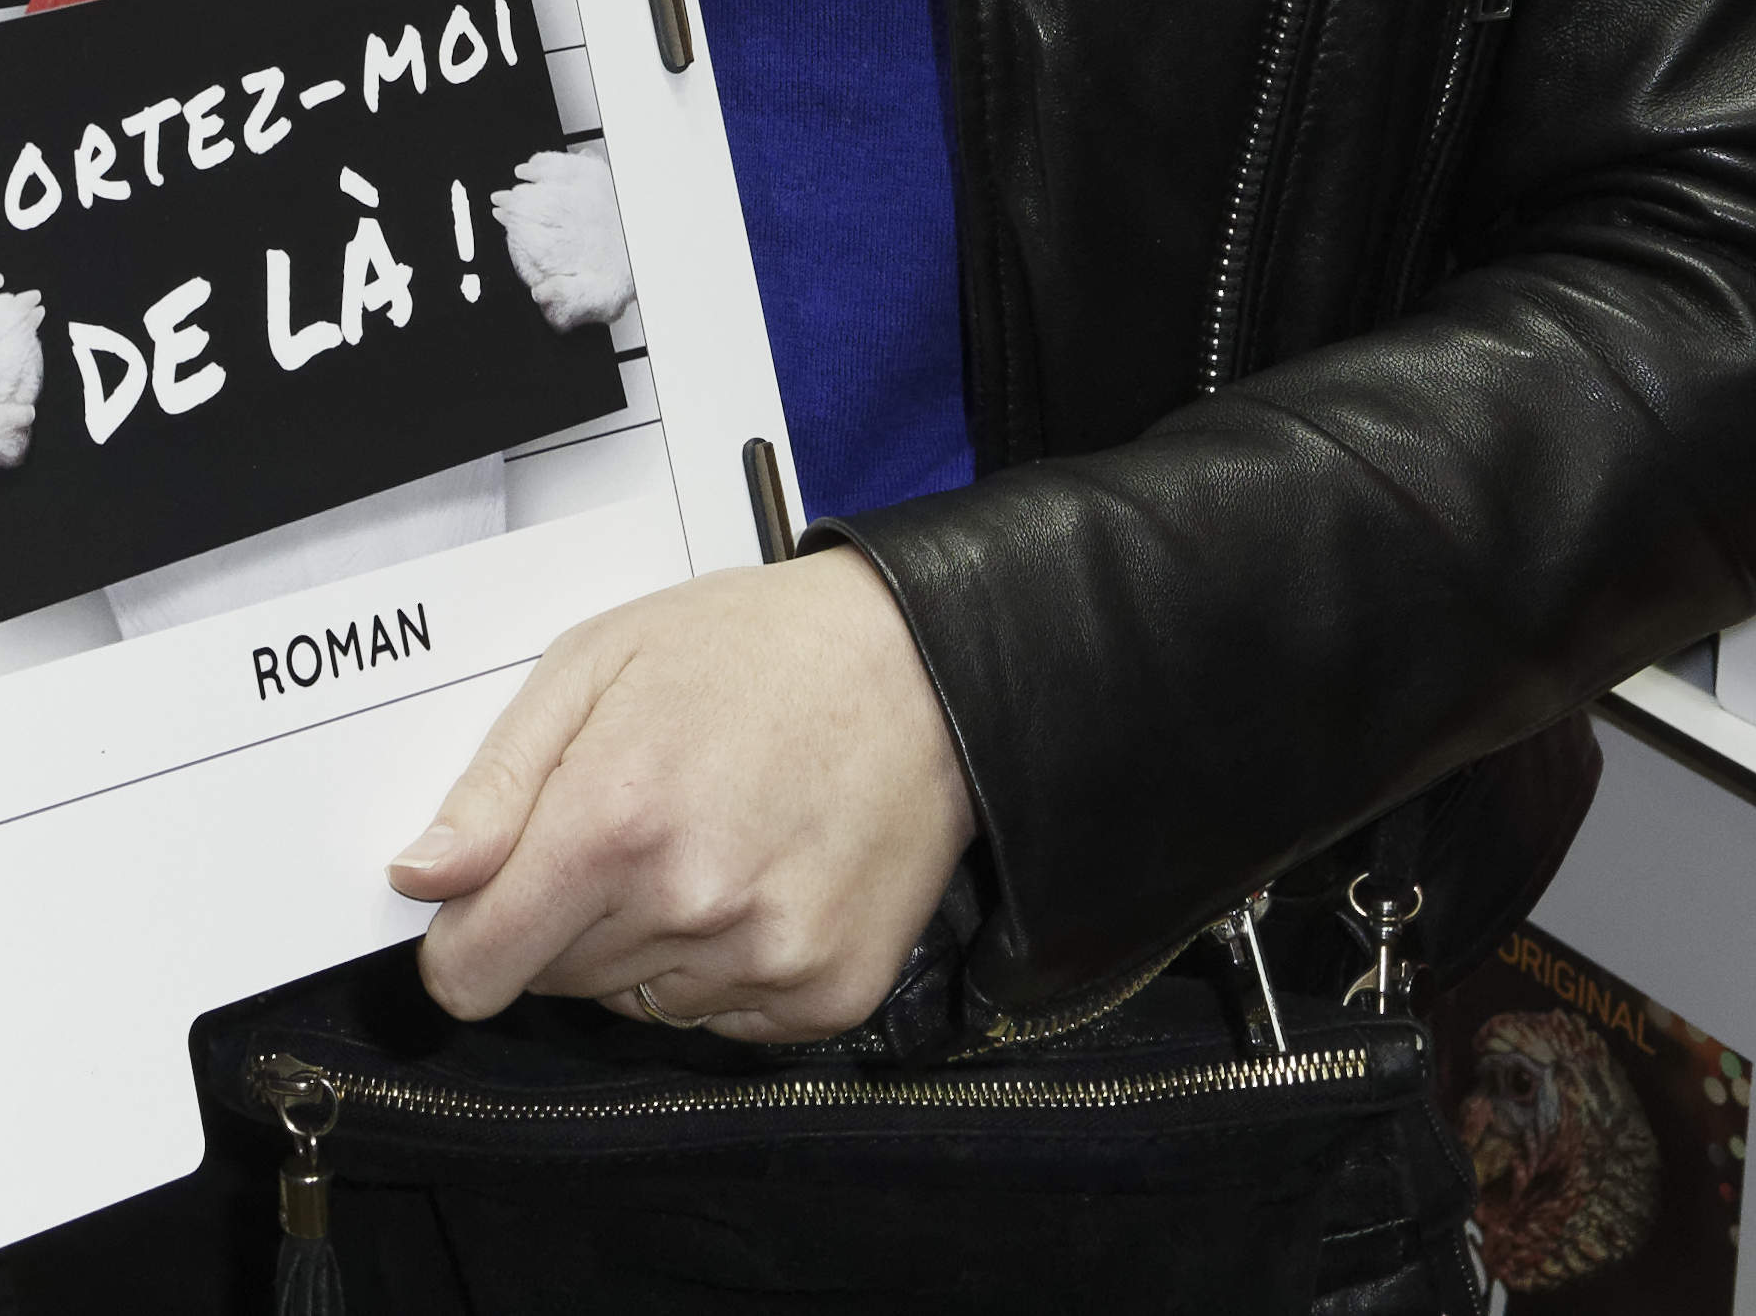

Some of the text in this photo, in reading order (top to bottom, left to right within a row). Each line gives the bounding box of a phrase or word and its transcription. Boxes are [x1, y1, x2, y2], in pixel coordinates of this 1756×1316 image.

[67, 165, 482, 445] DE LÀ !
[252, 601, 433, 701] ROMAN
